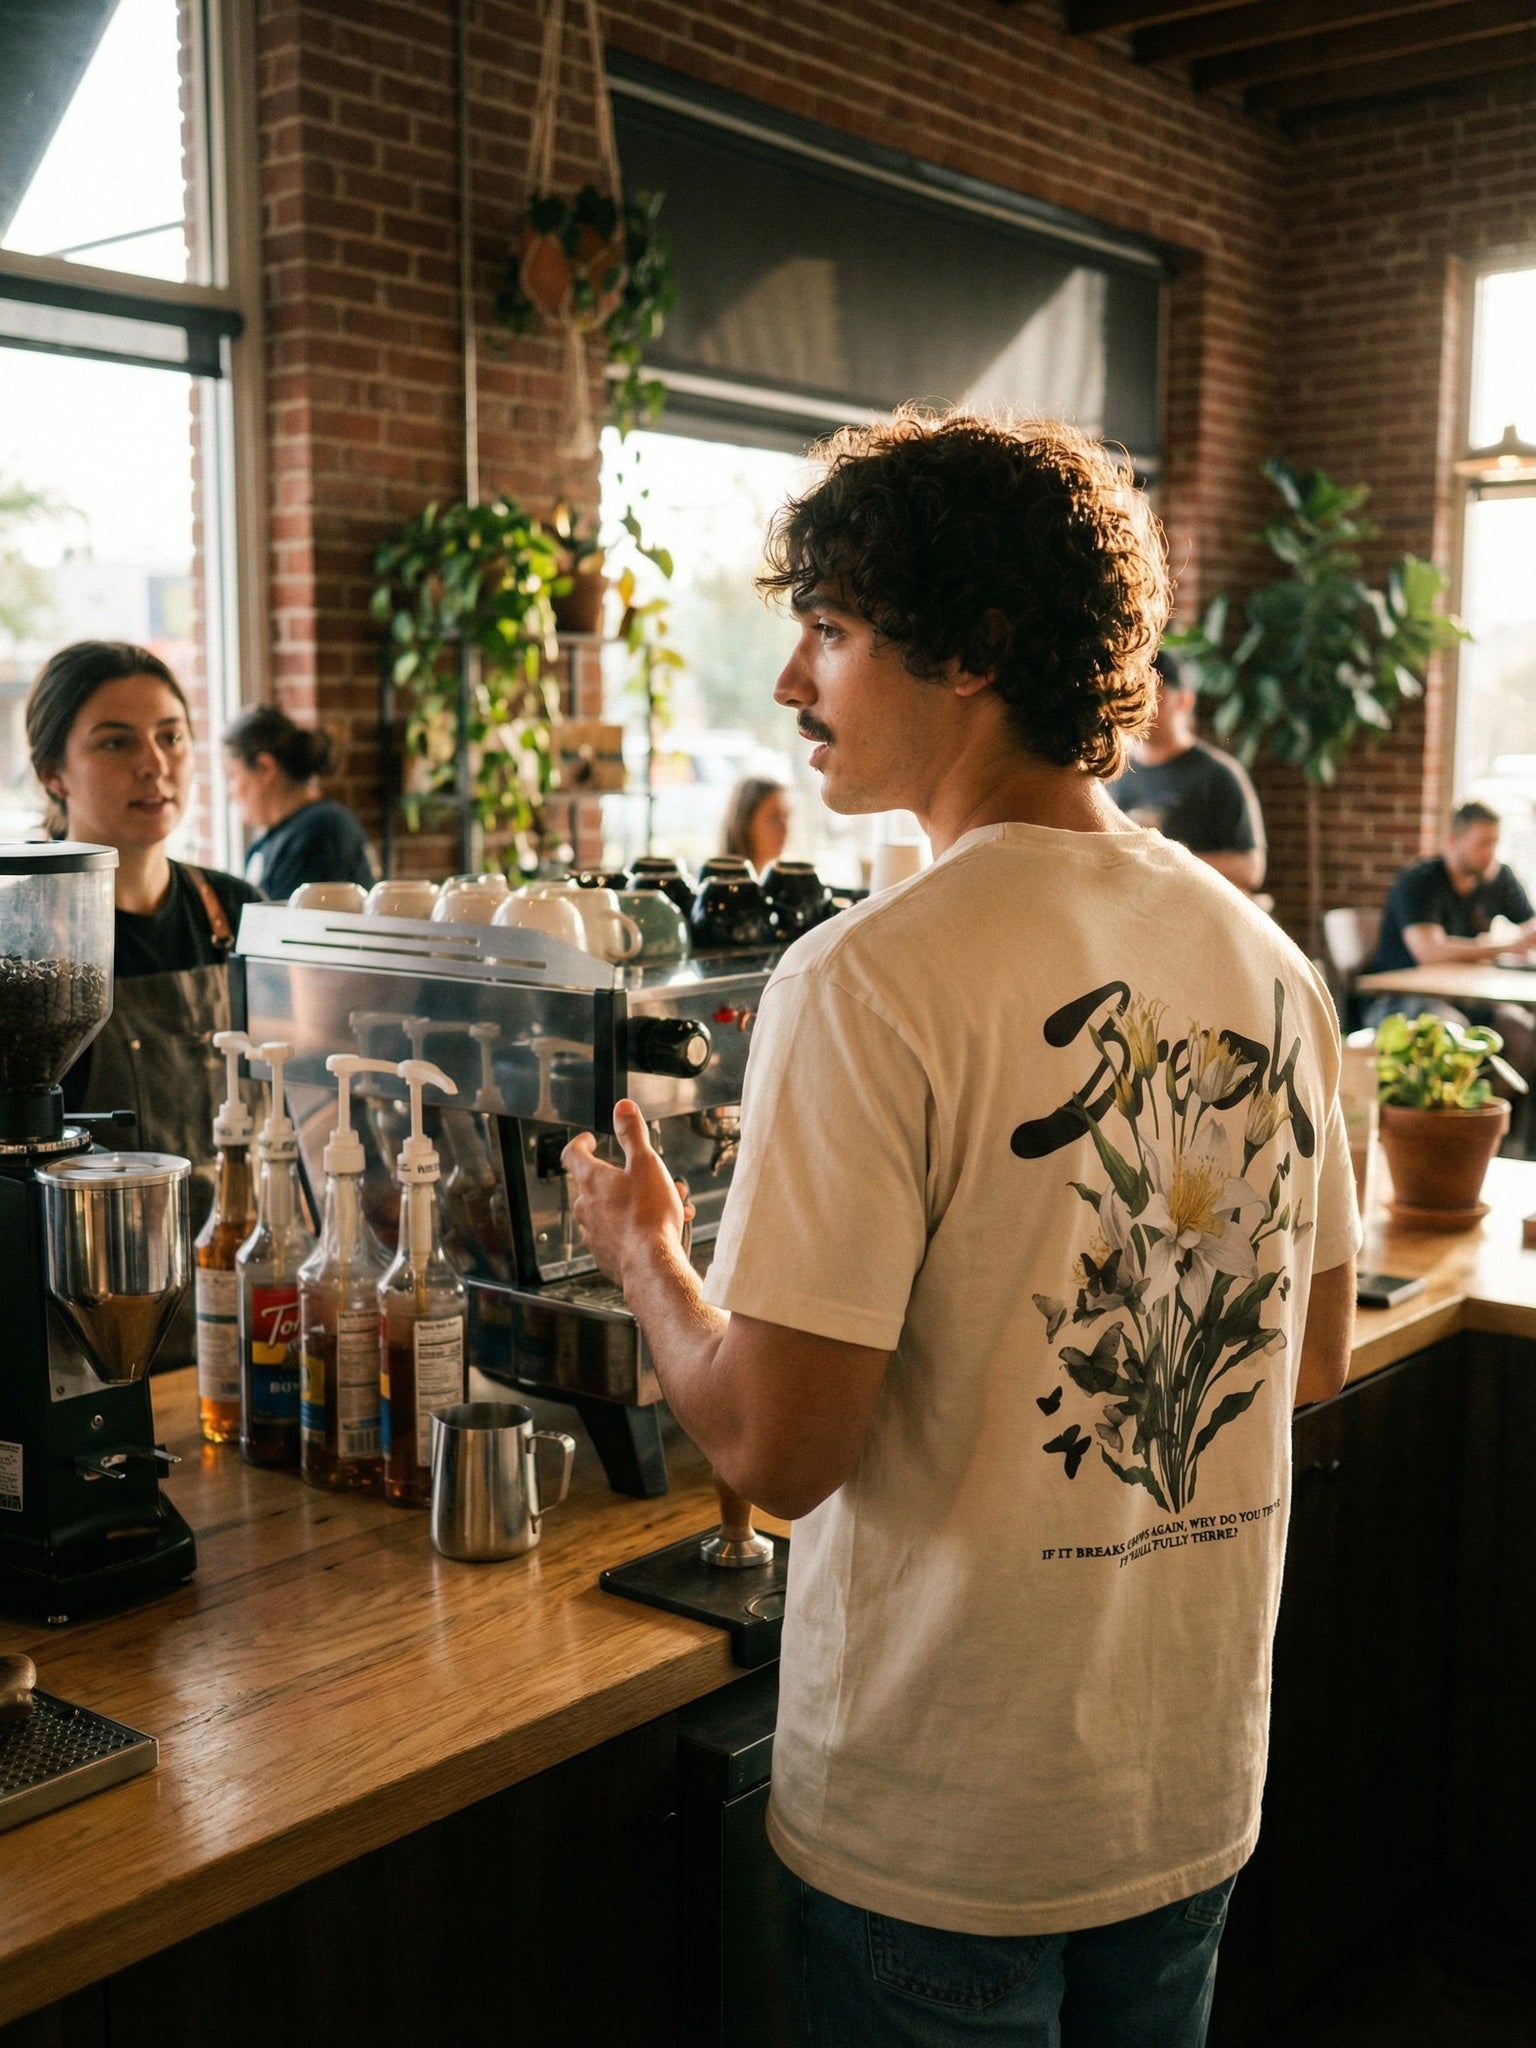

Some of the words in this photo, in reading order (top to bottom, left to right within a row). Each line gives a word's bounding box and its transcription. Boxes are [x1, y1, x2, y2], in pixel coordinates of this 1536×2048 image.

[1042, 1549, 1056, 1560] IF
[1058, 1548, 1073, 1559] IT
[1076, 1543, 1125, 1558] BREAKS
[1219, 1513, 1237, 1526] DO
[1238, 1509, 1260, 1523] YOU
